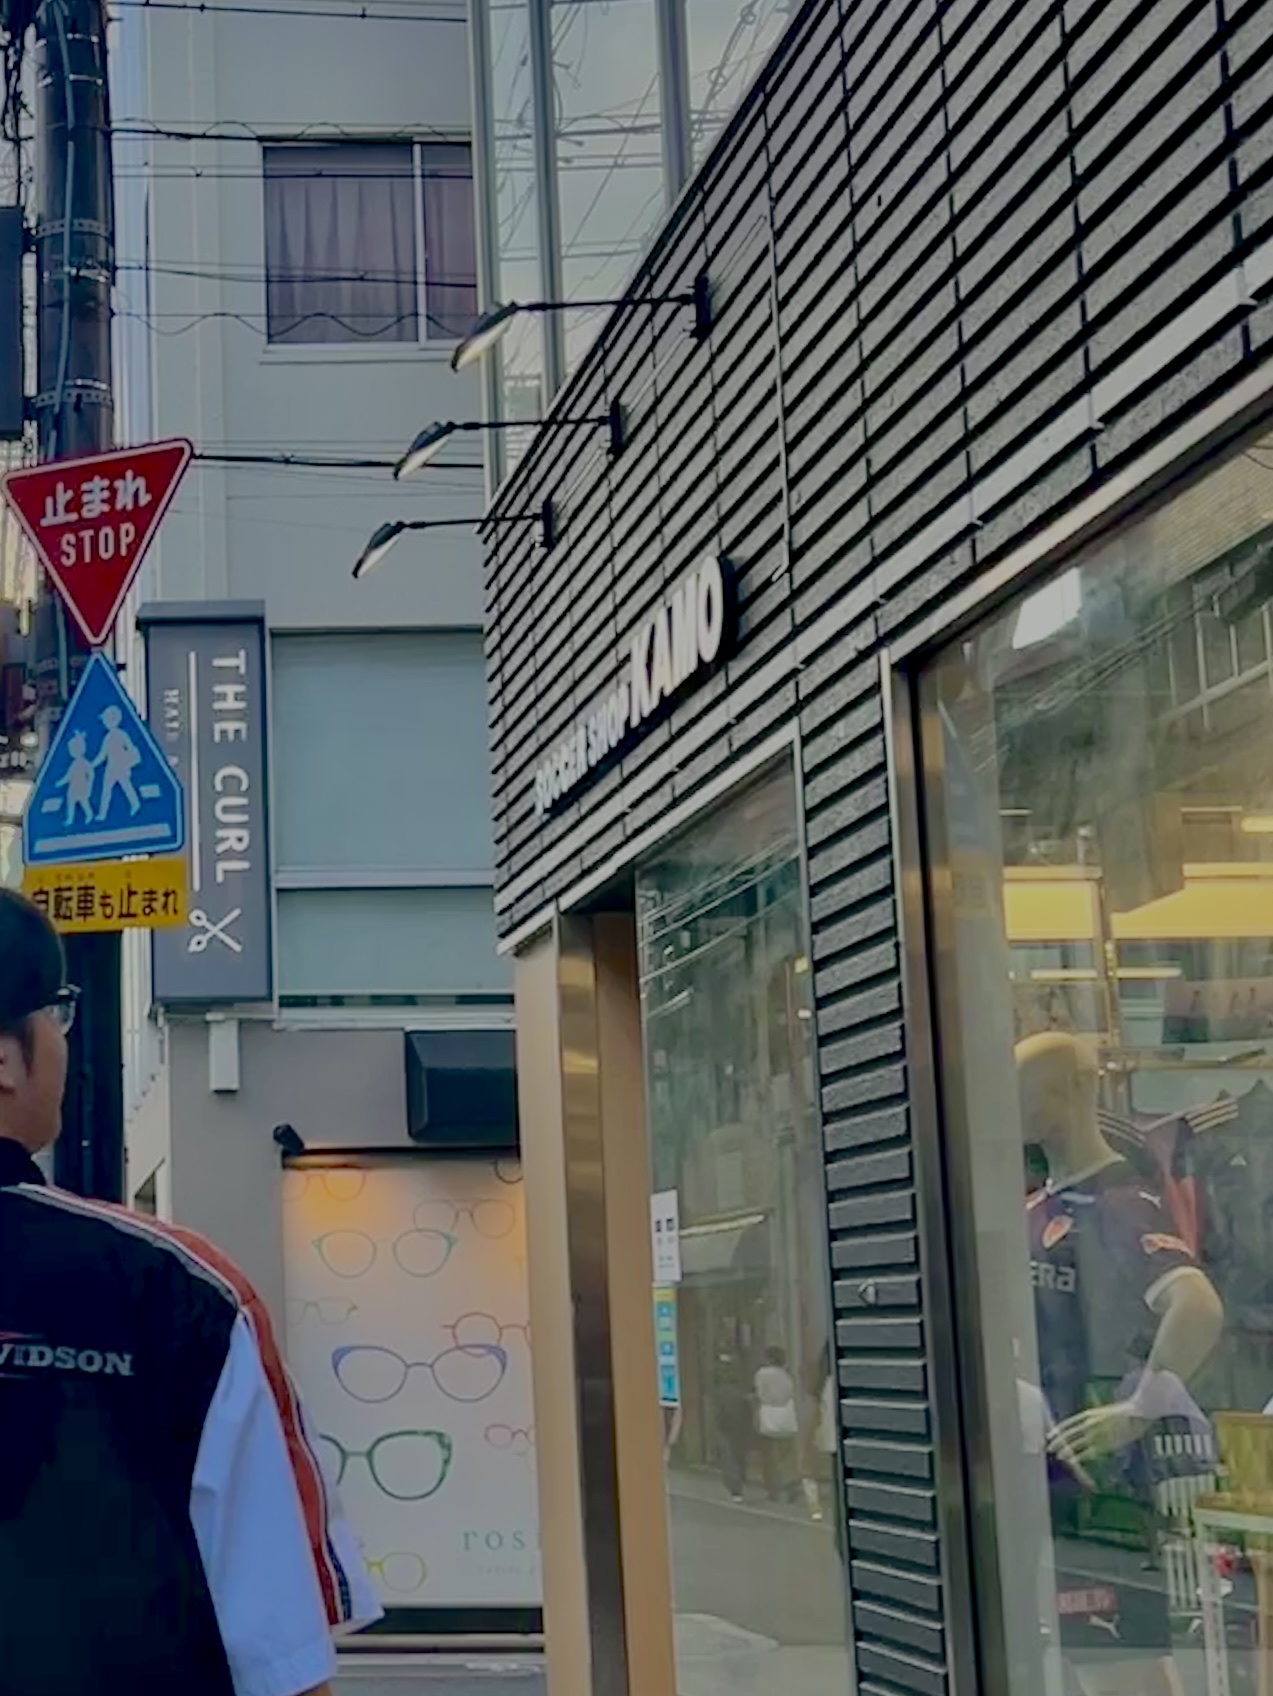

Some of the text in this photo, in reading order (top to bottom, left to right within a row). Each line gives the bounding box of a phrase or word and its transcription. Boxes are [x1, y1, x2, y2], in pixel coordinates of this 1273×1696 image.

[39, 468, 153, 527] 止まれ
[60, 521, 136, 568] STOP
[629, 555, 725, 729] KAMO
[211, 649, 251, 884] THE CURL
